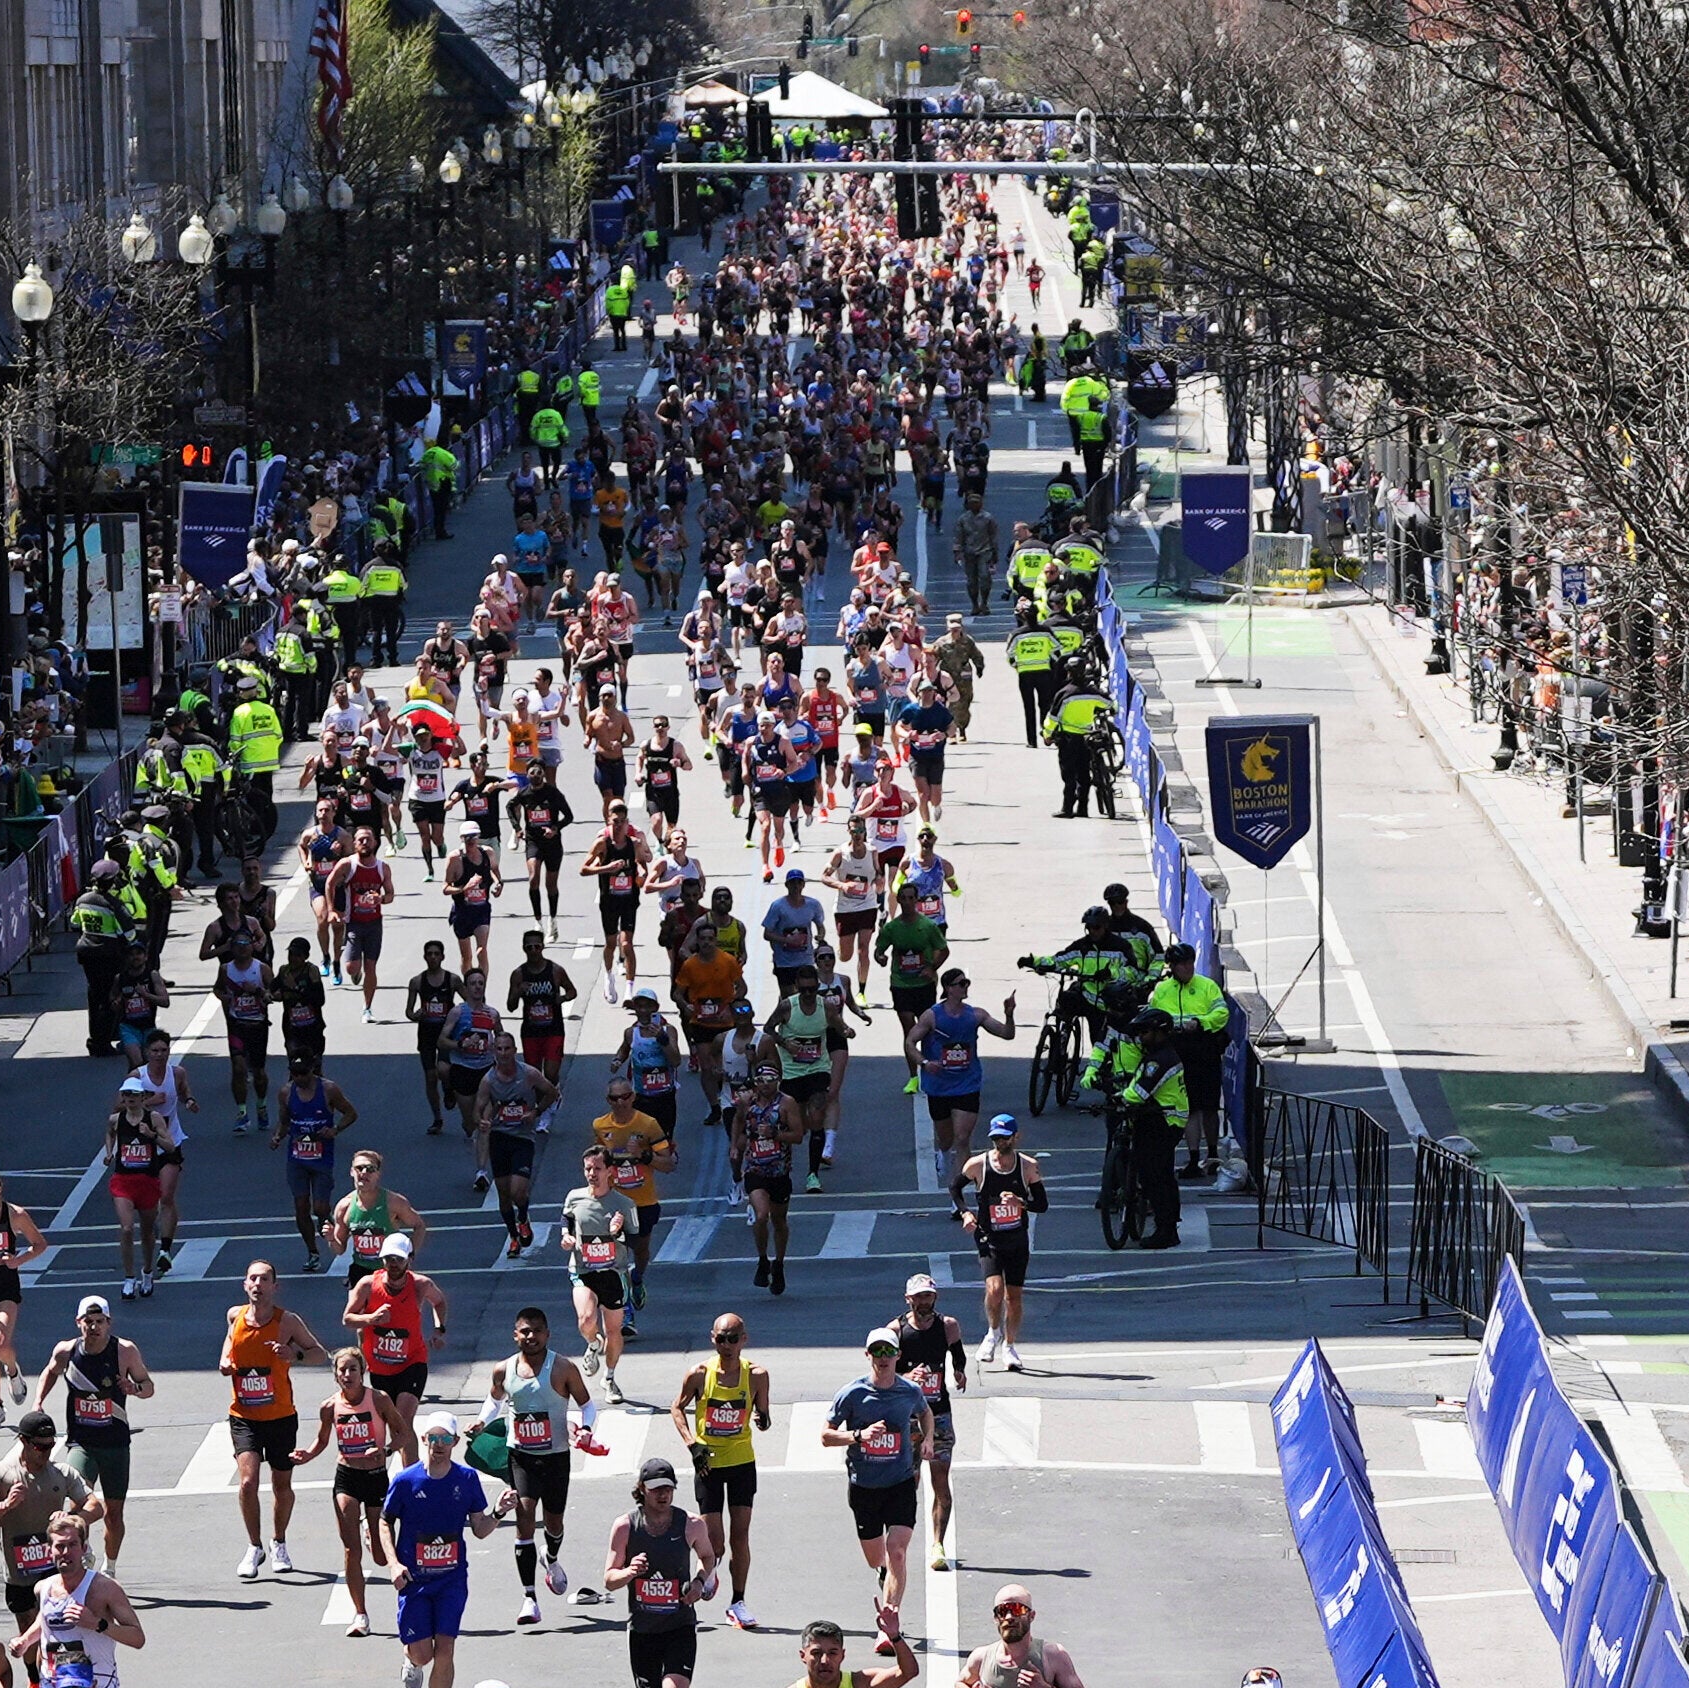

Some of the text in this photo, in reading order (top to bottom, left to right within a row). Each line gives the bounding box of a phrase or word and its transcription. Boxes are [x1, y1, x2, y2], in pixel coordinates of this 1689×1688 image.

[1233, 784, 1288, 801] BOSTON
[1234, 797, 1288, 812] MARATHON
[356, 1235, 381, 1249] 2814
[586, 1244, 612, 1258] 4538
[377, 1338, 405, 1353] 2192
[240, 1377, 268, 1391] 4058
[79, 1400, 106, 1413] 6756
[712, 1407, 740, 1423] 4362
[341, 1424, 369, 1439] 3748
[518, 1421, 545, 1436] 4108
[424, 1544, 452, 1559] 3822
[641, 1582, 673, 1597] 4552
